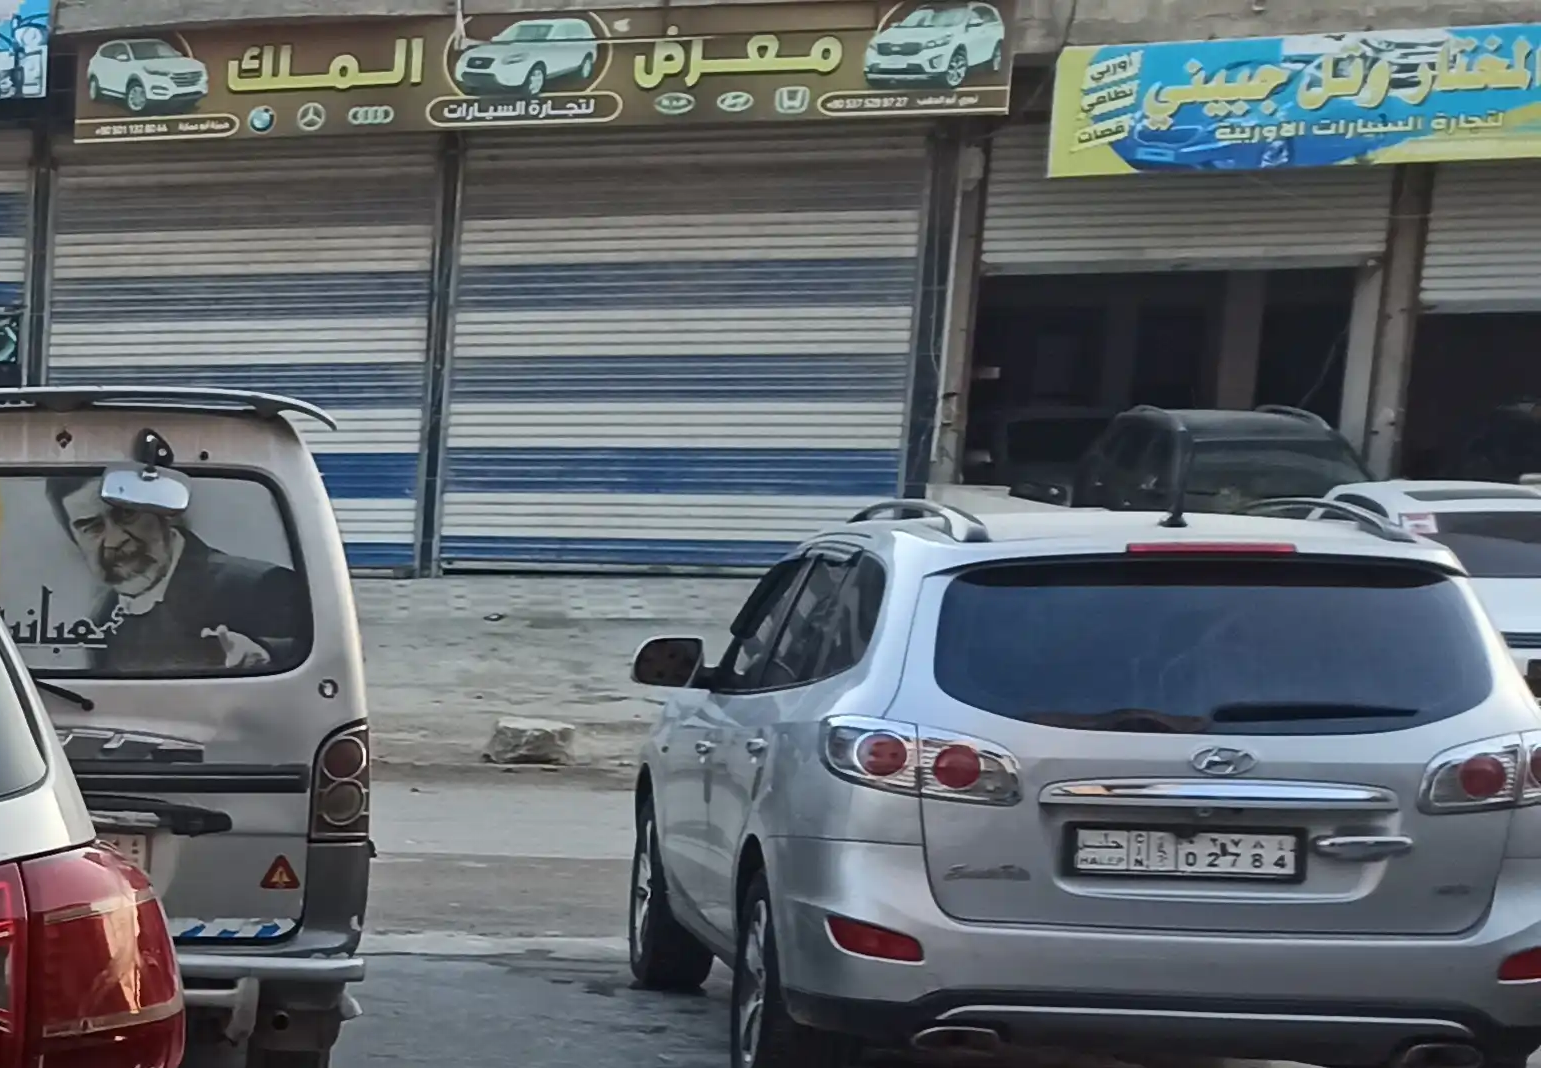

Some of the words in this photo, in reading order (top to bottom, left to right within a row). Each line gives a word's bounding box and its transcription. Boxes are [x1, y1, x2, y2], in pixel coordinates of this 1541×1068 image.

[227, 38, 424, 93] الملك
[633, 25, 843, 88] معرض
[443, 100, 526, 120] السيارات
[528, 98, 594, 118] لتجارة
[1312, 114, 1422, 139] السيارات
[1431, 111, 1504, 132] لتجارة
[1185, 850, 1288, 869] 02784
